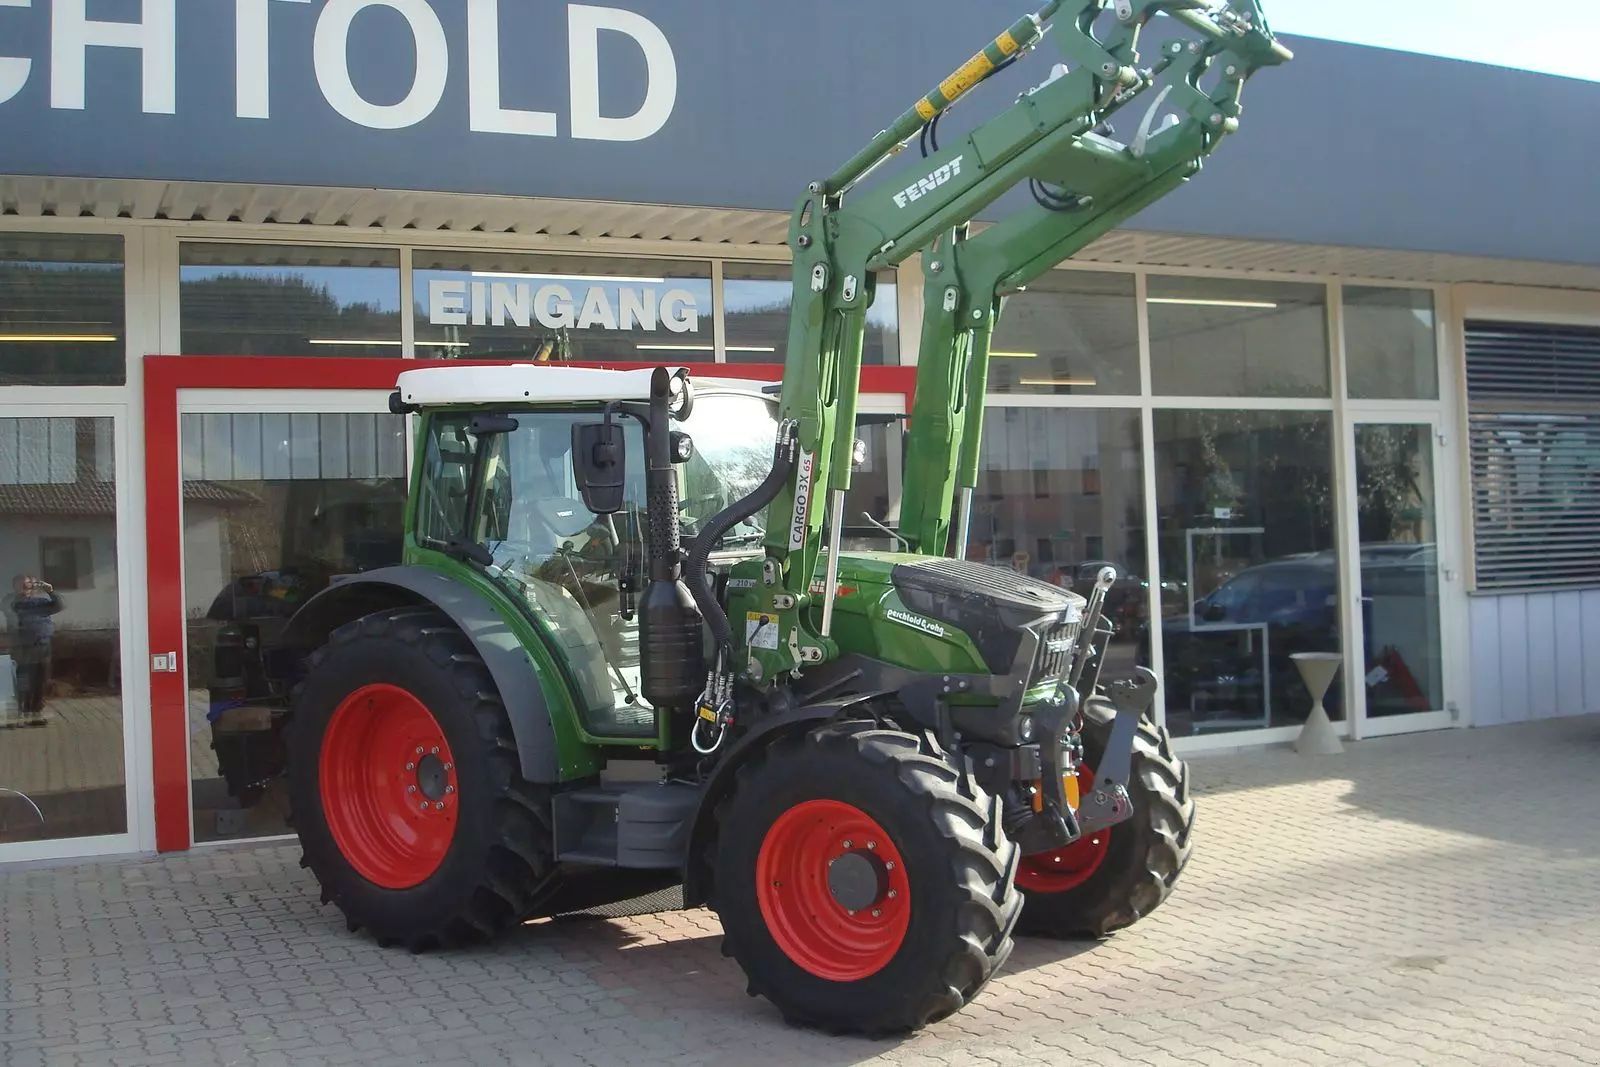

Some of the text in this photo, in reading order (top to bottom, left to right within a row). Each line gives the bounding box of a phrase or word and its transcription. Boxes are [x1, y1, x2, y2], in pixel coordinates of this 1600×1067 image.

[0, 0, 678, 142] HTOLD
[892, 154, 963, 208] FENDT
[429, 279, 699, 333] EINGANG
[792, 459, 811, 544] CARGO 3X 65
